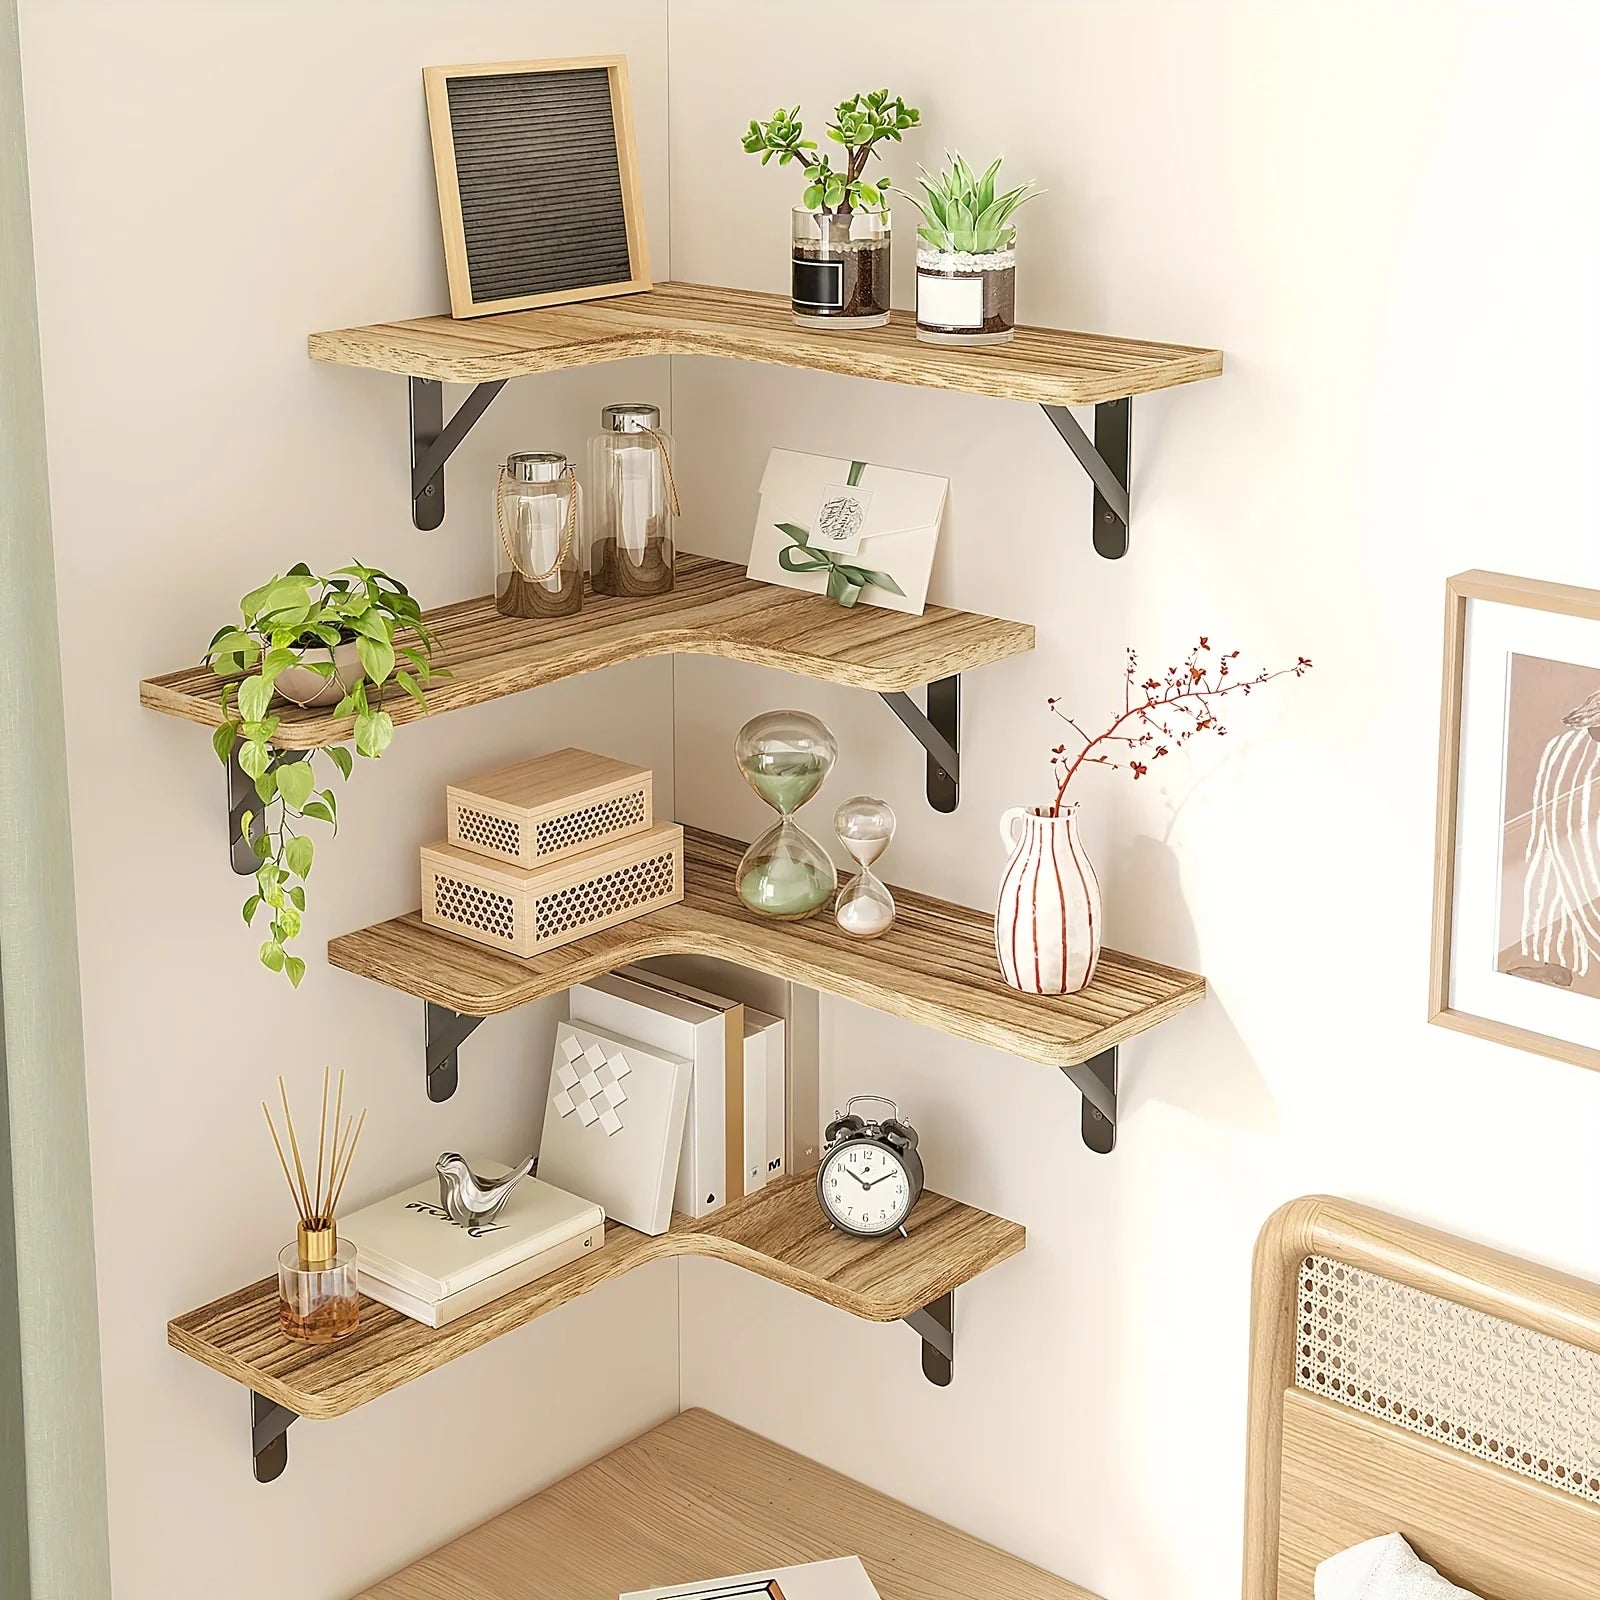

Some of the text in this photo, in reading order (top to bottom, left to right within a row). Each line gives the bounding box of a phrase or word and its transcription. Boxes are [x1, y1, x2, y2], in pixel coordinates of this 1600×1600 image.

[849, 1153, 857, 1162] 11
[863, 1150, 873, 1160] 12
[768, 1157, 781, 1172] M
[837, 1163, 846, 1173] 10
[891, 1168, 898, 1178] 2
[831, 1178, 838, 1187] 9
[895, 1185, 902, 1194] 3
[834, 1194, 842, 1203] 8
[891, 1200, 896, 1210] 4
[847, 1206, 853, 1216] 7
[879, 1209, 886, 1219] 5
[862, 1212, 869, 1222] 6
